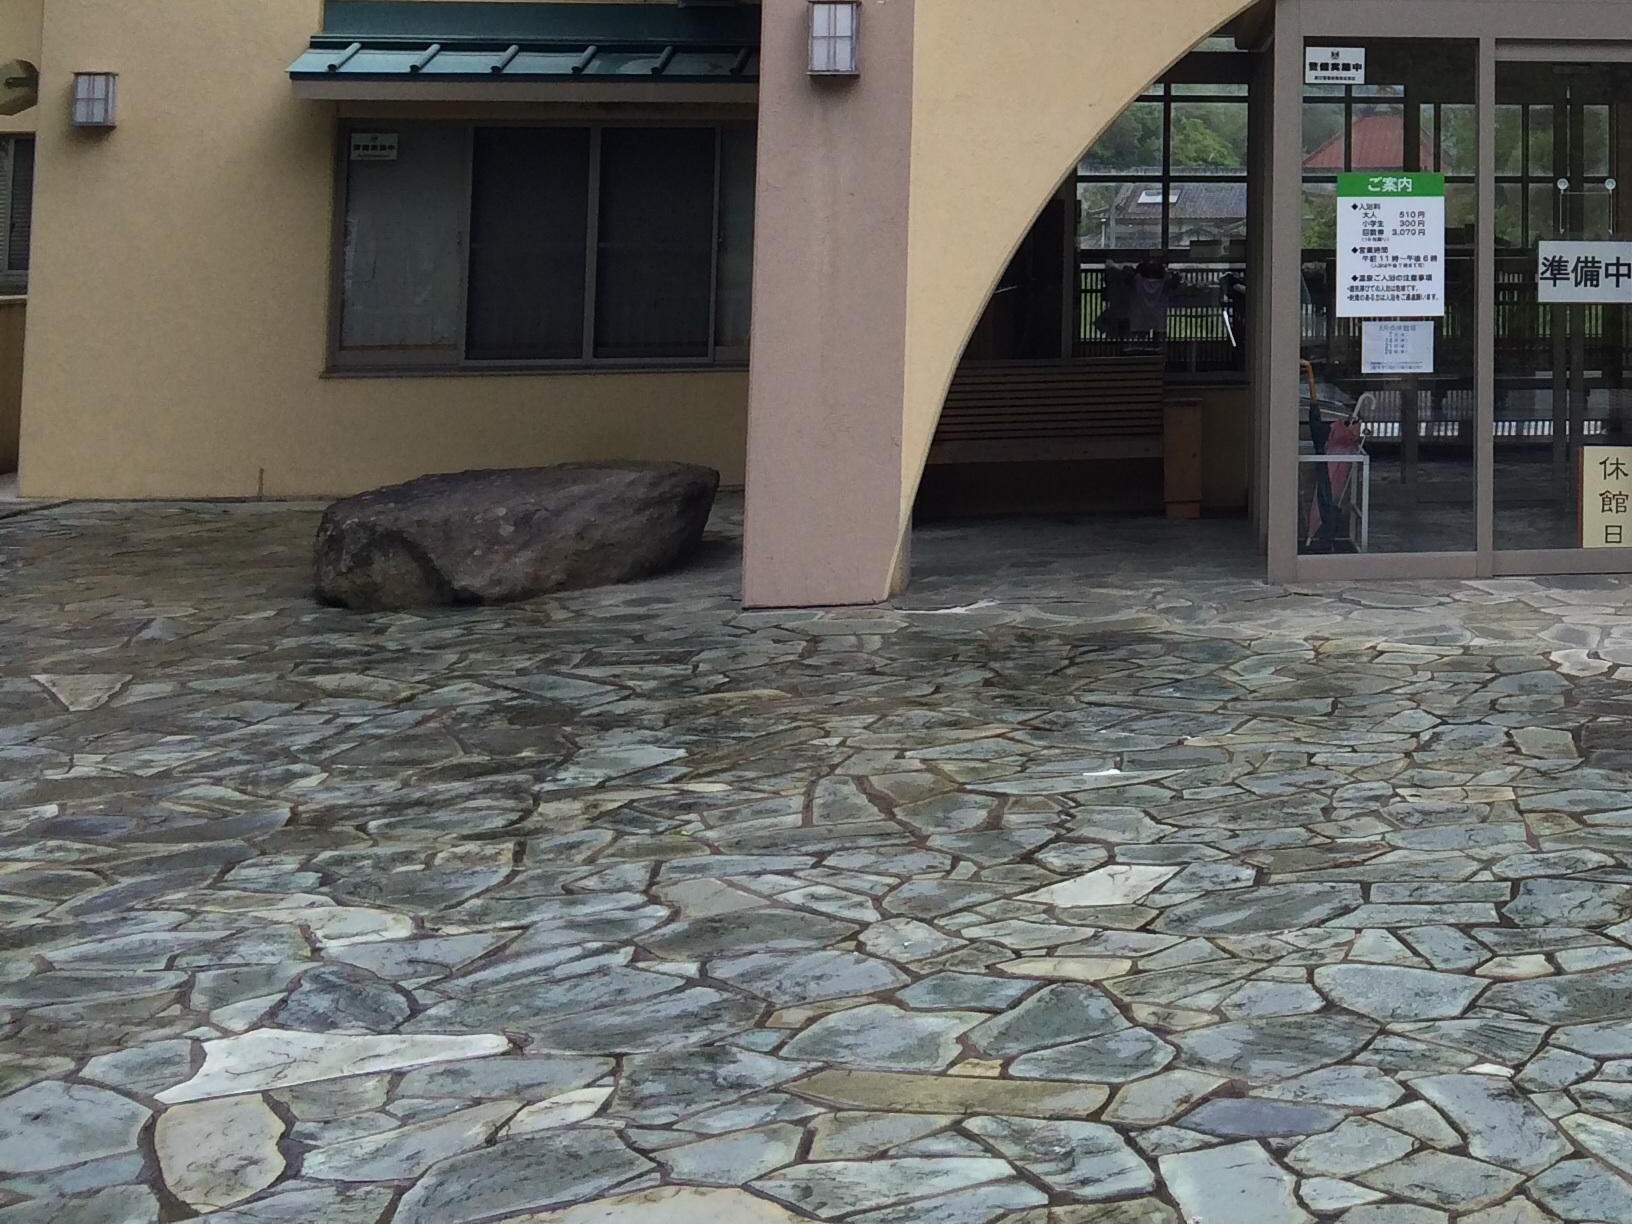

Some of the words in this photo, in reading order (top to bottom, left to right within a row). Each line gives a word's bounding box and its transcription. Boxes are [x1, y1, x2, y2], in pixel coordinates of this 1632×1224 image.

[1367, 177, 1413, 193] ご案内
[1362, 211, 1377, 219] 大人
[1361, 220, 1384, 228] 小学生
[1539, 255, 1632, 289] 準備中
[1598, 456, 1629, 544] 休館日
